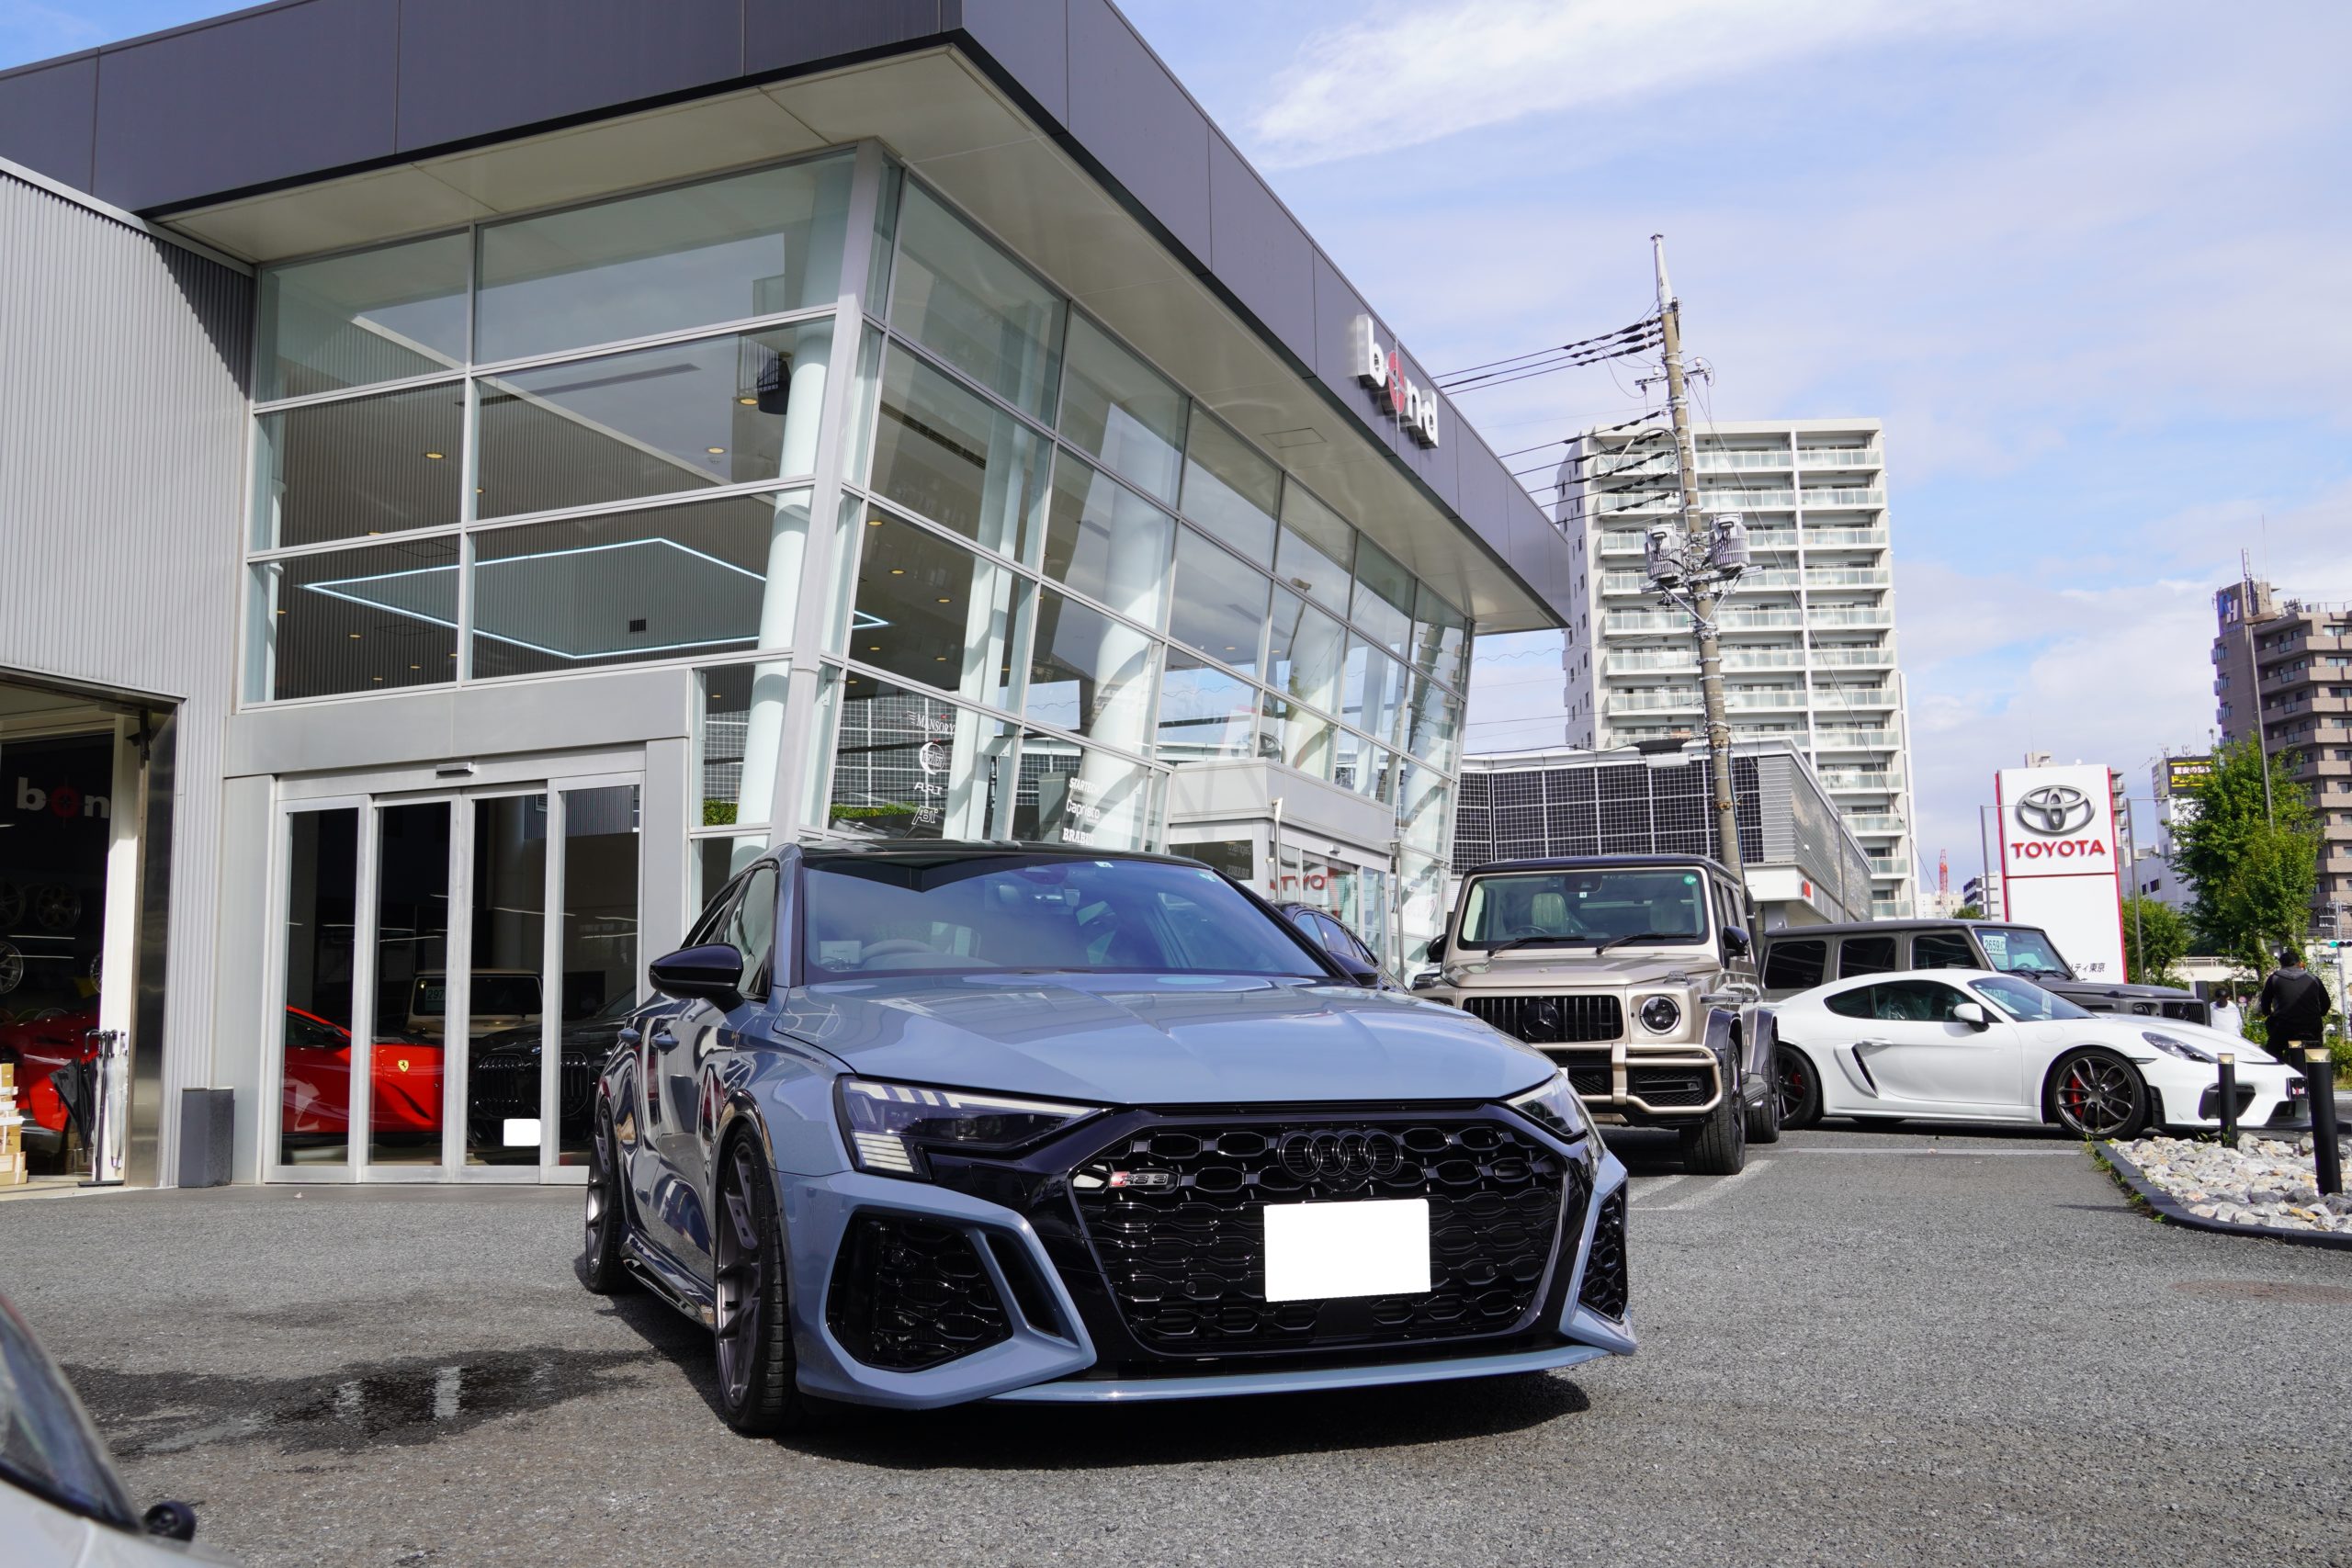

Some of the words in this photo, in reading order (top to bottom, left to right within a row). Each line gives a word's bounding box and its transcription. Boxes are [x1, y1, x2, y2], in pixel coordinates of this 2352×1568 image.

[1358, 314, 1439, 448] bond
[917, 713, 956, 736] MANSORY
[1062, 827, 1094, 845] BRABUS
[2010, 839, 2106, 860] TOYOTA
